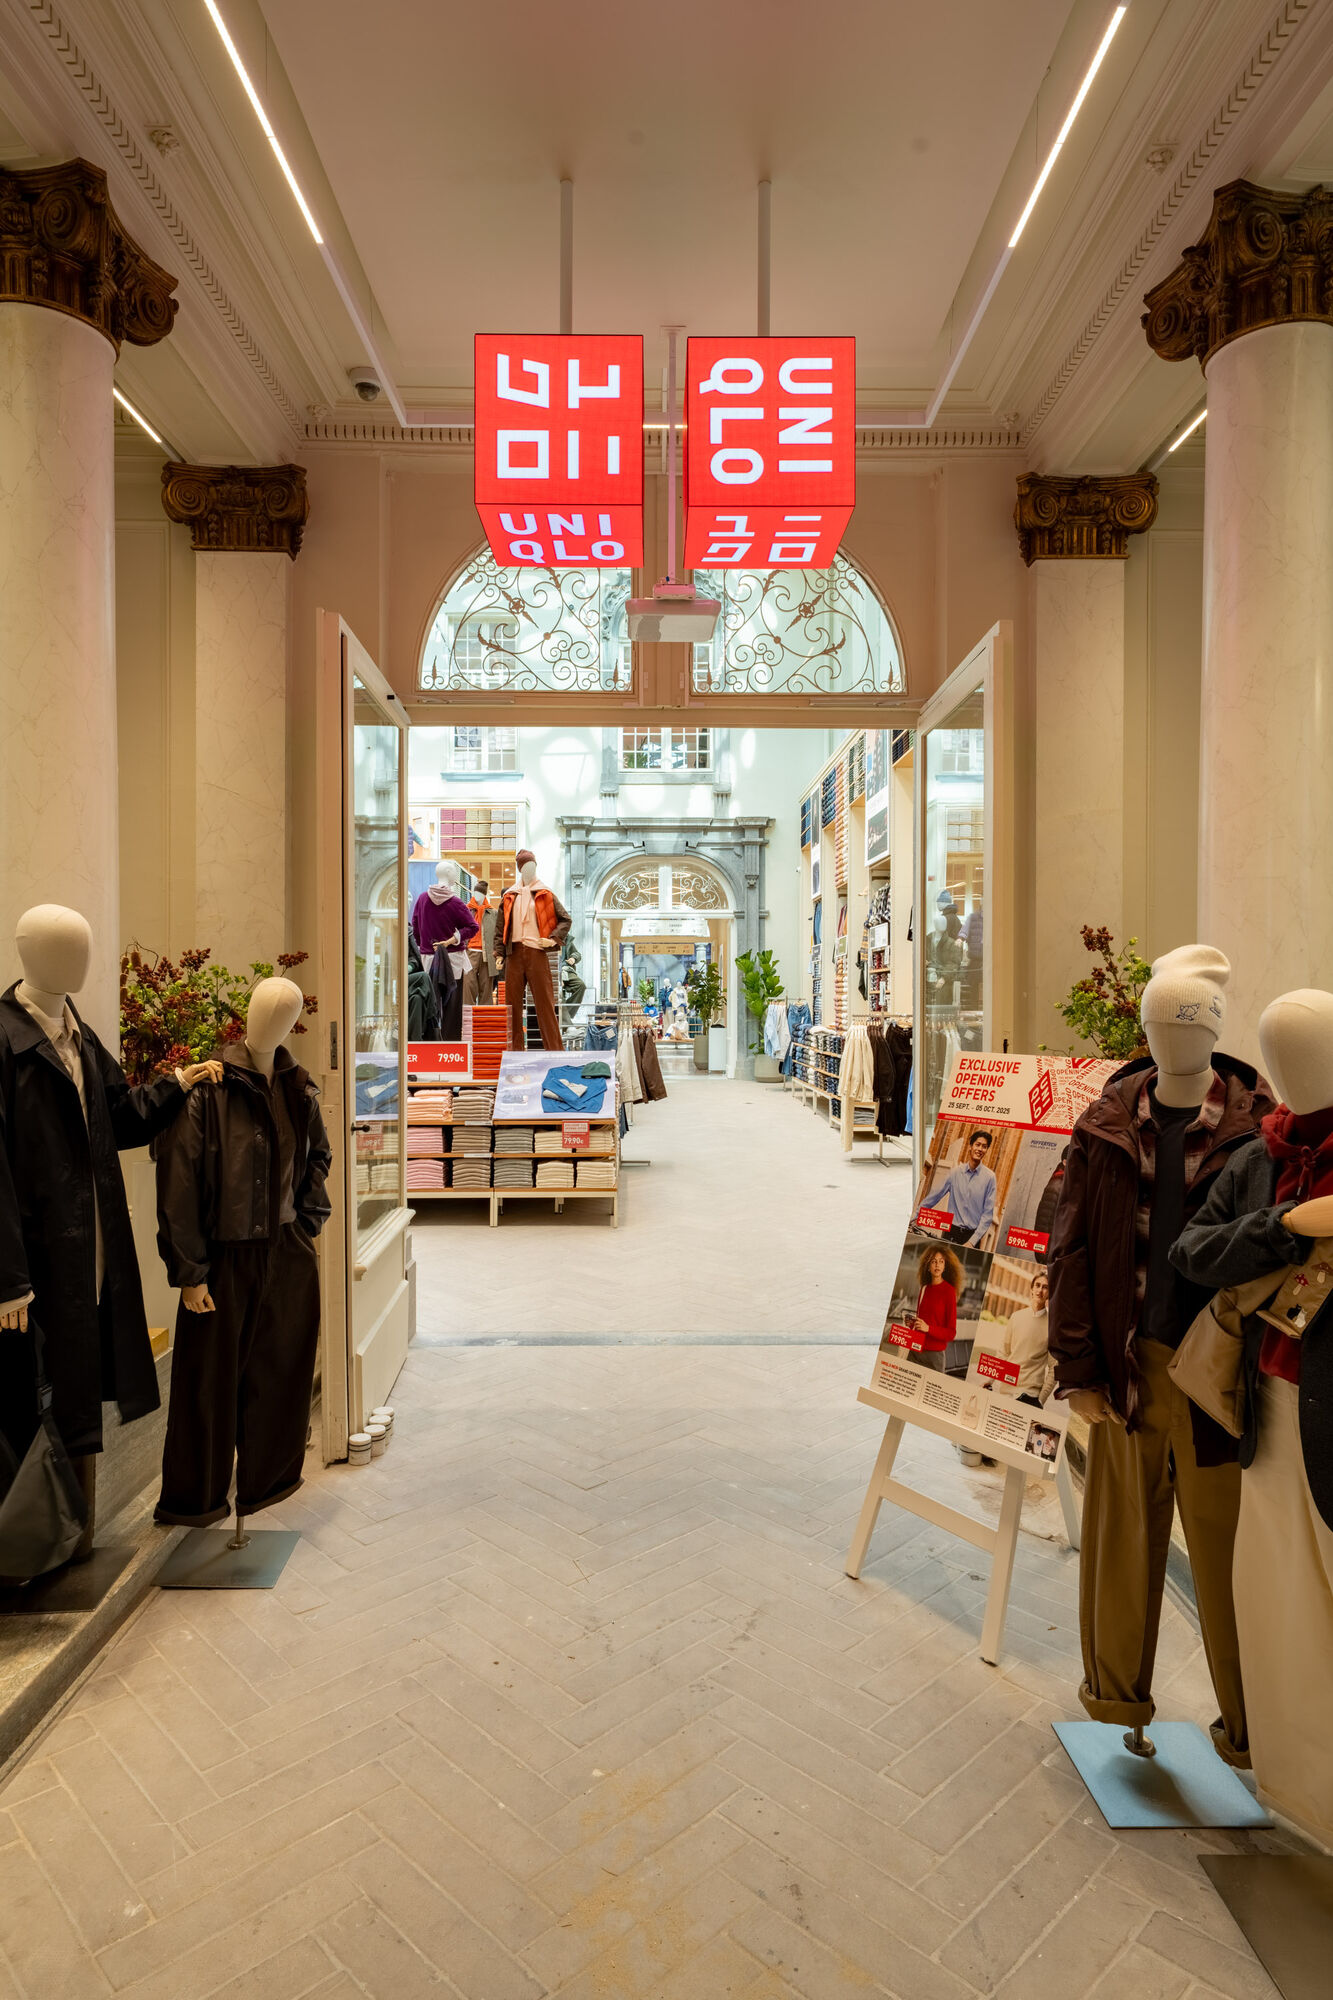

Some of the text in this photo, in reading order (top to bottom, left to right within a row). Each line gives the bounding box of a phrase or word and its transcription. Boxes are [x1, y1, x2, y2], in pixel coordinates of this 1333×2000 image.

[699, 357, 765, 485] QLO
[778, 357, 833, 473] UNI
[499, 512, 612, 536] UNI
[508, 539, 625, 564] QLO
[959, 1058, 1021, 1074] EXCLUSIVE
[955, 1072, 1005, 1088] OPENING
[1040, 1076, 1050, 1108] UNI
[951, 1086, 996, 1102] OFFERS
[1030, 1087, 1042, 1119] QLO
